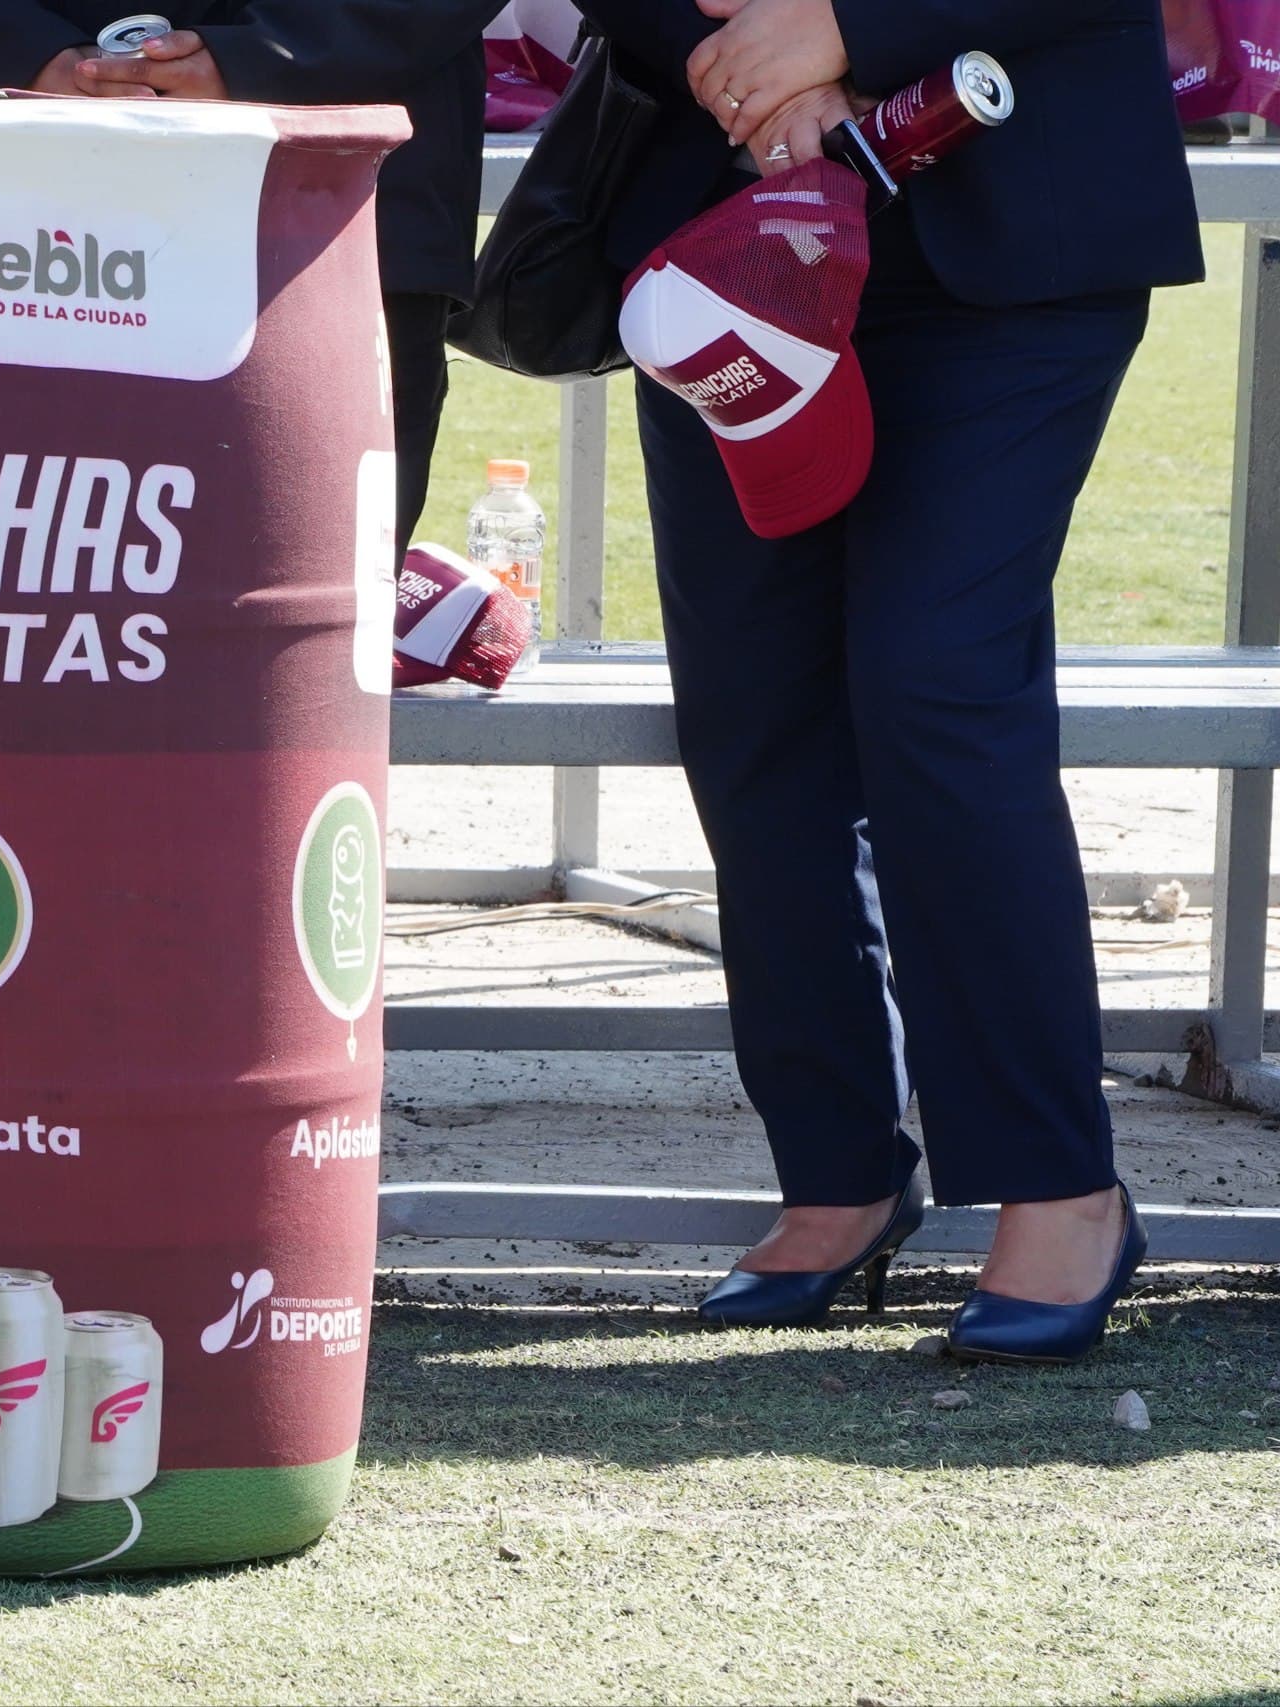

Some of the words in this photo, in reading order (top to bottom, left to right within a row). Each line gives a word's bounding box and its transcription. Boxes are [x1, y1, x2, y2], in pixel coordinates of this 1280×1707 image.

[12, 303, 38, 318] DE
[44, 305, 68, 320] LA
[74, 308, 147, 327] CIUDAD
[679, 355, 758, 400] CANCHAS
[719, 374, 767, 404] LATAS
[270, 1297, 311, 1308] INSTITUTO
[270, 1307, 362, 1341] DEPORTE
[324, 1342, 337, 1357] DE
